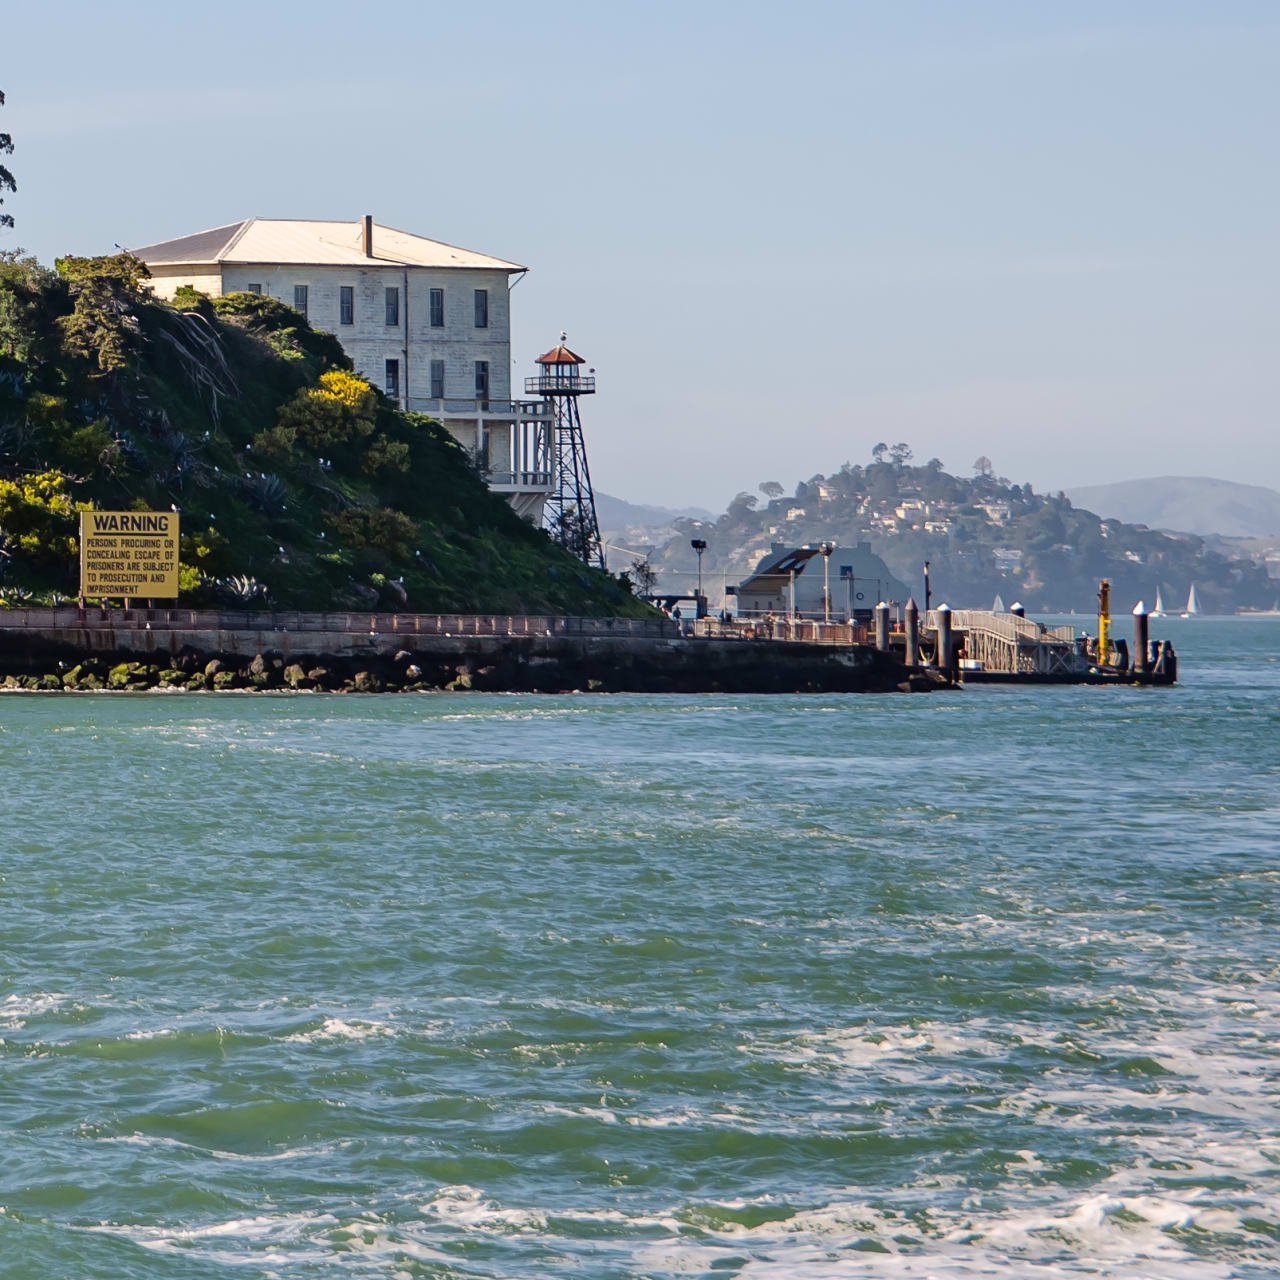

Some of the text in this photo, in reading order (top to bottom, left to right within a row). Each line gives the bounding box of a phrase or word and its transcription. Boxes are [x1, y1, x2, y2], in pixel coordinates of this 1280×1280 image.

[94, 515, 168, 531] WARNING
[87, 539, 174, 548] PERSONS PROCURING OR
[87, 550, 174, 560] CONCEALING ESCAPE OF
[87, 562, 174, 571] PRISONERS ARE SUBJECT
[88, 573, 165, 582] TO PROSECUTION AND
[87, 585, 138, 594] IMPRISONMENT
